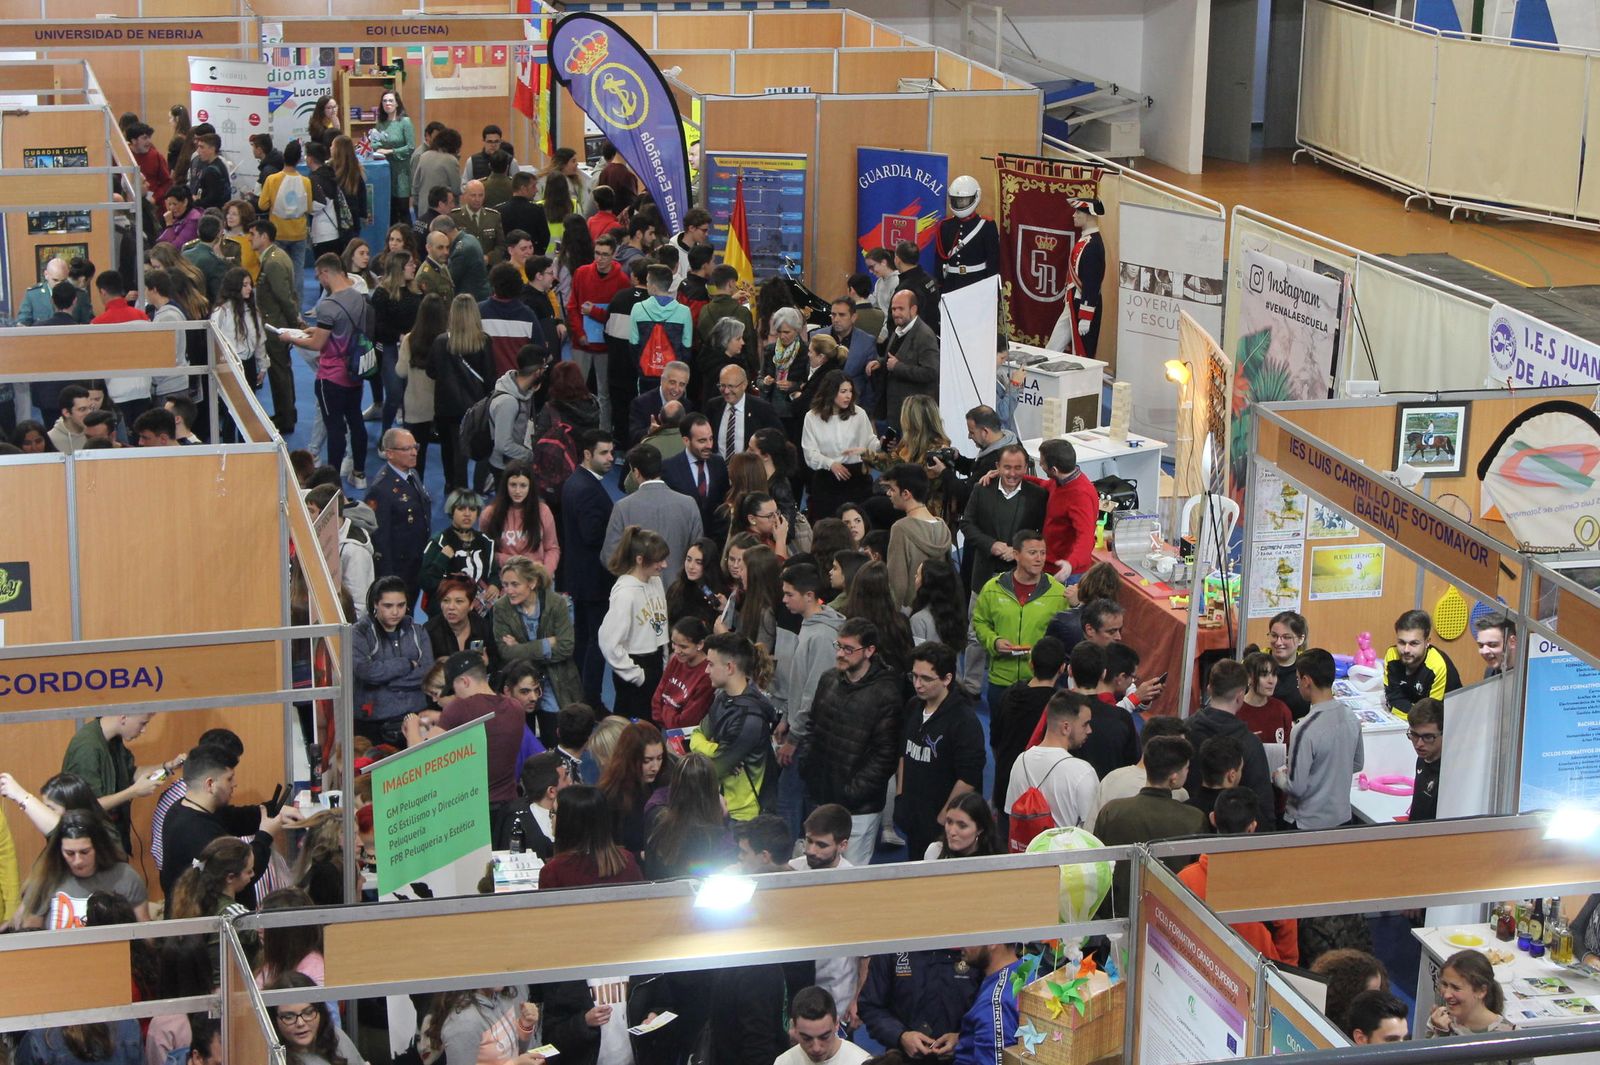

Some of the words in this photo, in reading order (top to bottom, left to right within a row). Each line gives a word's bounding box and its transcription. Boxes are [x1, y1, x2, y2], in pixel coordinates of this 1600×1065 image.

[35, 29, 123, 40] UNIVERSIDAD
[127, 29, 144, 39] DE
[148, 29, 203, 39] NEBRIJA
[366, 26, 387, 36] EOI
[390, 25, 449, 36] (LUCENA)
[267, 68, 327, 82] diomas
[293, 87, 331, 97] Lucena
[859, 164, 912, 189] GUARDIA
[915, 168, 944, 197] REAL
[1126, 294, 1181, 314] JOYERÍA
[1267, 271, 1321, 309] Instagram
[1127, 310, 1135, 321] Y
[1265, 301, 1328, 333] #VENALAESCUELA
[1524, 327, 1556, 360] I.E.S
[1561, 344, 1600, 381] JUAN
[1516, 358, 1534, 386] DE
[1017, 392, 1044, 407] ERÍA
[1289, 436, 1306, 461] IES
[1308, 448, 1332, 476] LUIS
[1334, 463, 1390, 509] CARRILLO
[1394, 494, 1408, 521] DE
[1411, 508, 1489, 567] SOTOMAYOR
[1353, 494, 1400, 541] (BAENA)
[1333, 552, 1381, 561] RESILIENCIA
[0, 666, 163, 696] CORDOBA)
[382, 766, 422, 795] IMAGEN
[424, 743, 477, 776] PERSONAL
[386, 805, 399, 819] GM
[400, 789, 438, 813] Peluquería
[387, 823, 398, 836] GS
[399, 809, 430, 831] Estilismo
[432, 807, 437, 818] y
[438, 791, 469, 814] Dirección
[469, 786, 479, 801] de
[388, 826, 426, 851] Peluquería
[390, 851, 403, 866] FPB
[404, 832, 443, 860] Peluquería
[443, 832, 449, 843] y
[449, 818, 475, 838] Estética
[1154, 907, 1169, 928] CICLO
[1168, 920, 1197, 954] FORMATIVO
[1196, 947, 1215, 972] GRADO
[1214, 965, 1239, 997] SUPERIOR
